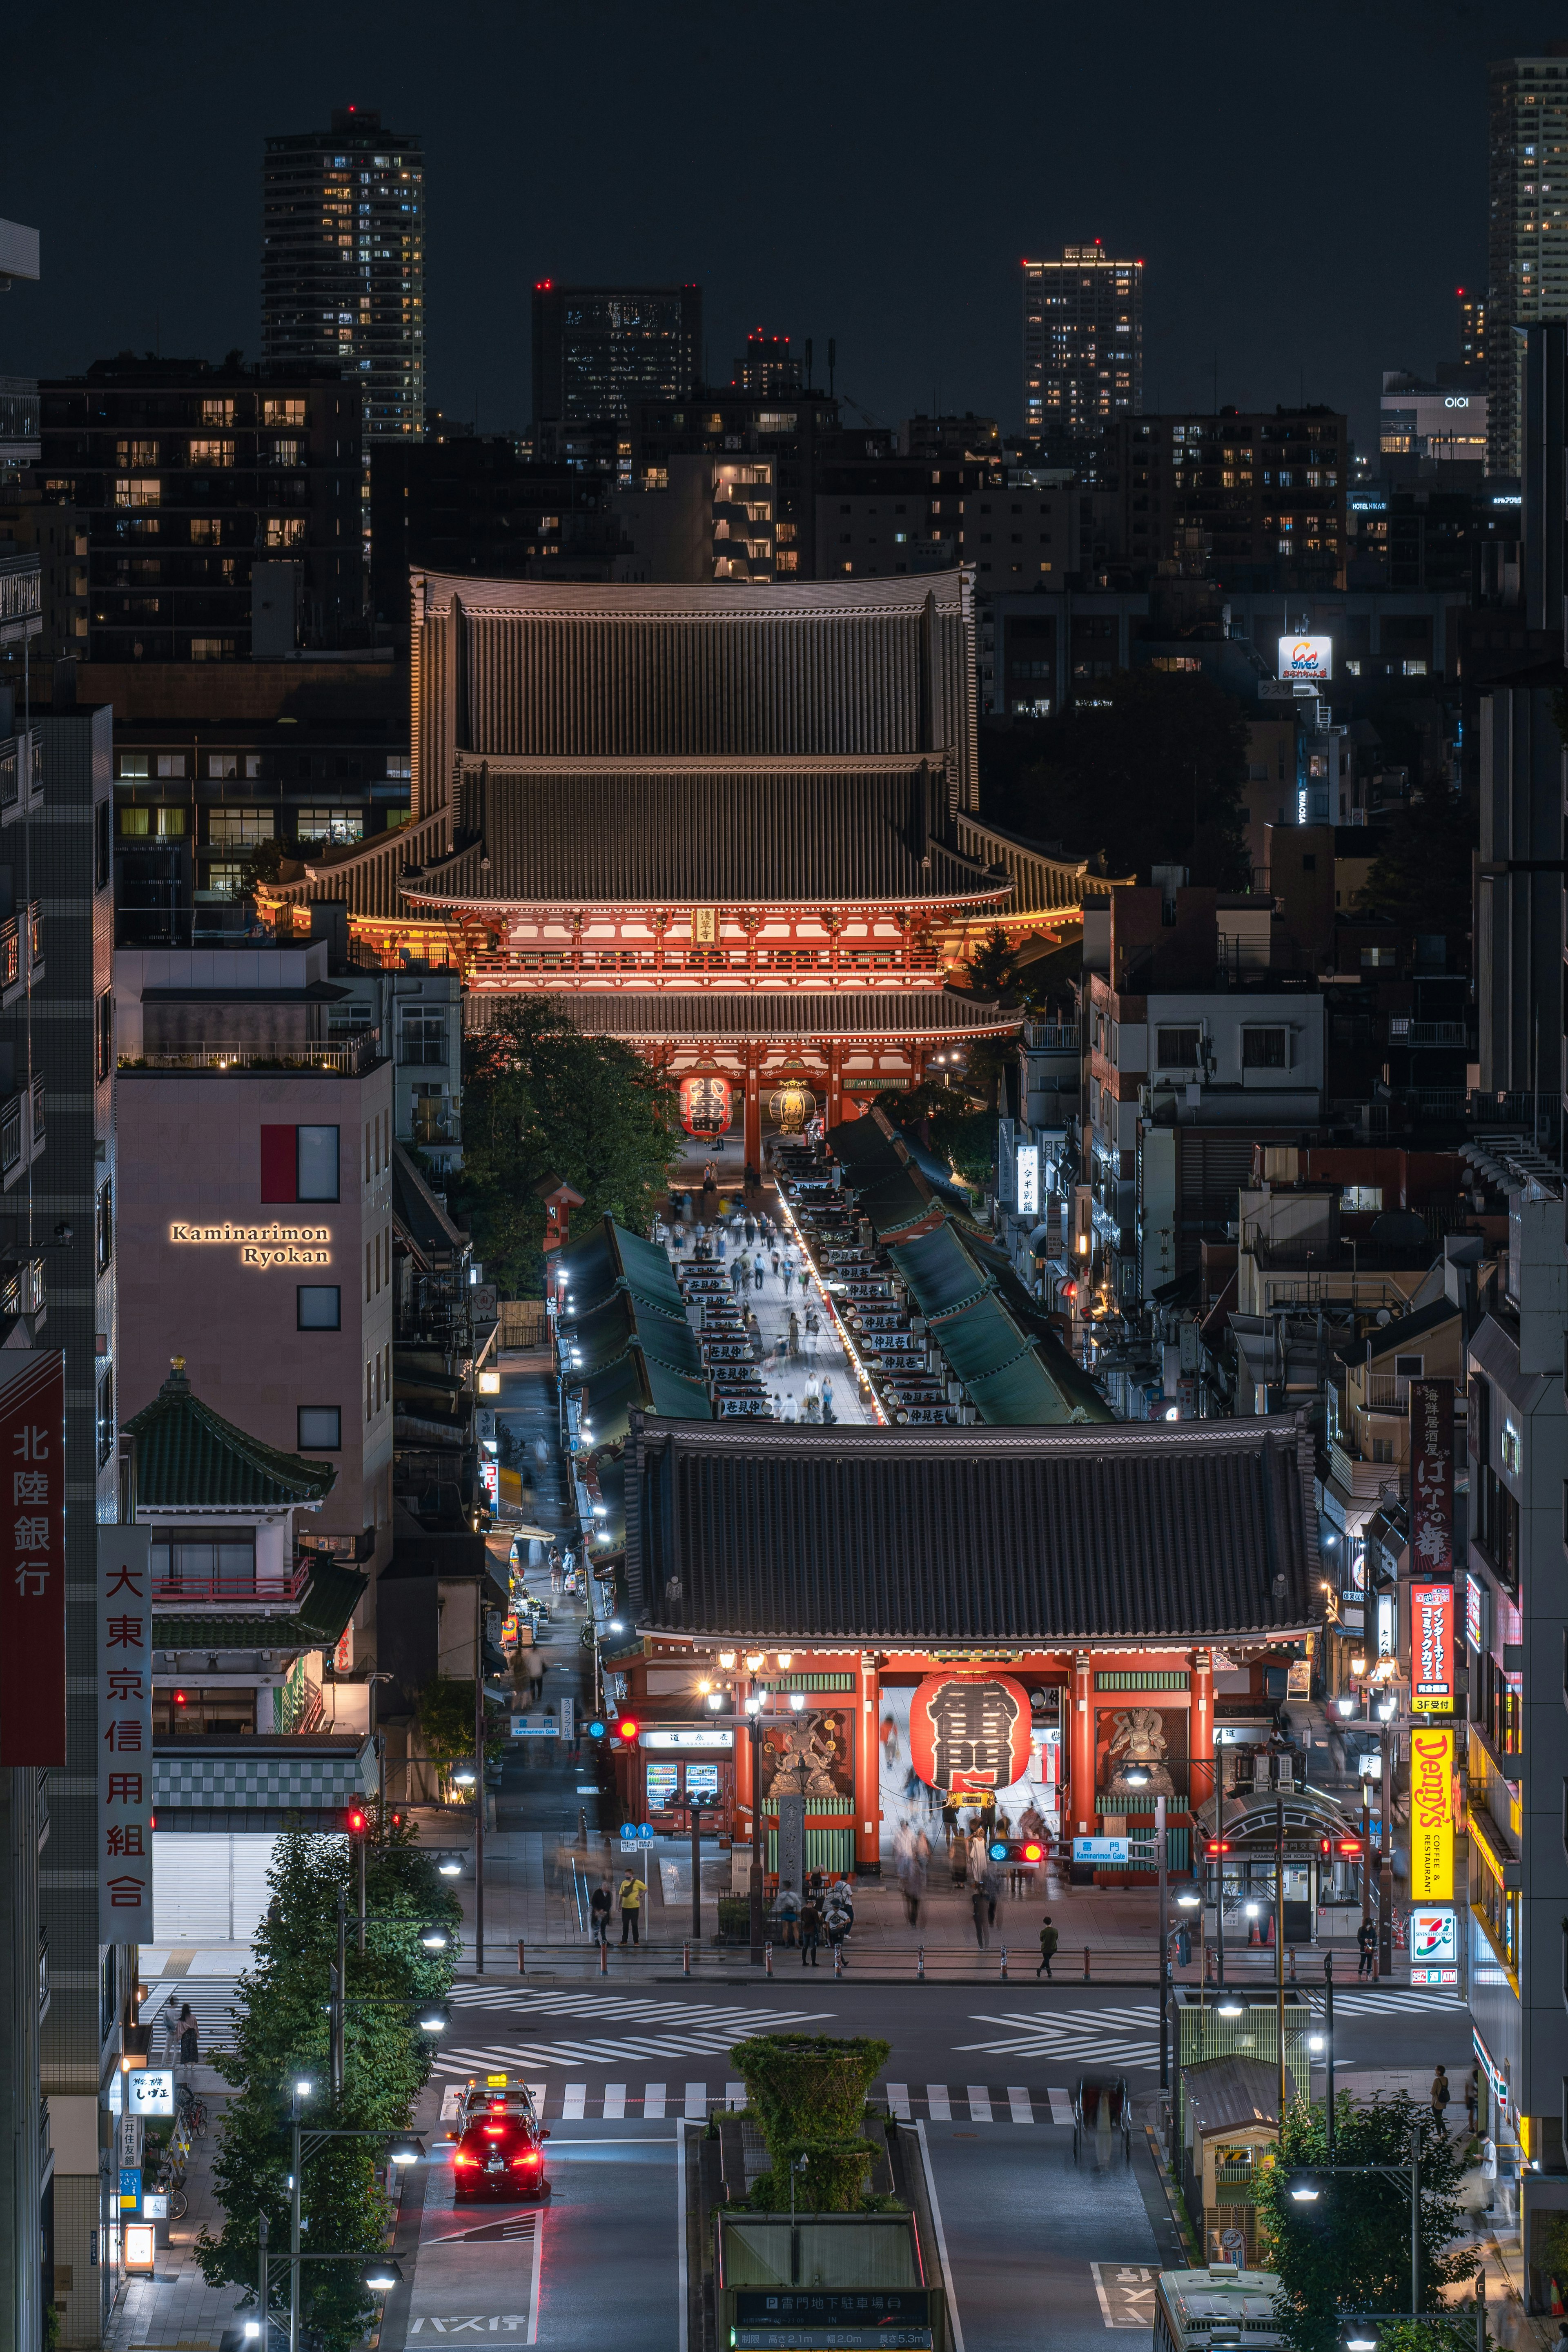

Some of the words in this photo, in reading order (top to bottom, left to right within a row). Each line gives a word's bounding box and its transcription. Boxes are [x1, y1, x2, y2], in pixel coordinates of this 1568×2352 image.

[1261, 685, 1290, 694] クスリ
[172, 1225, 328, 1240] Kaminarimon
[243, 1248, 328, 1266] Ryokan
[1425, 1389, 1439, 1457] 海鮮居酒屋
[13, 1425, 50, 1597] 北陸銀行
[1415, 1460, 1449, 1565] はなの舞
[1416, 1593, 1449, 1601] 自遊空間
[1417, 1701, 1449, 1709] 3F受付
[519, 1719, 552, 1727] 雷門
[104, 1564, 146, 1907] 大東京信用組合
[927, 1680, 1019, 1791] 雷門
[1414, 1735, 1450, 1828] Denny's
[1082, 1842, 1119, 1851] 雷門
[1413, 1972, 1426, 1981] たばこ
[1430, 1971, 1439, 1982] 酒
[1443, 1971, 1455, 1981] ATM
[137, 2088, 169, 2100] しげ正
[782, 2297, 884, 2309] 雷門地下駐車場
[411, 2315, 526, 2333] バス停
[742, 2334, 760, 2343] 制限
